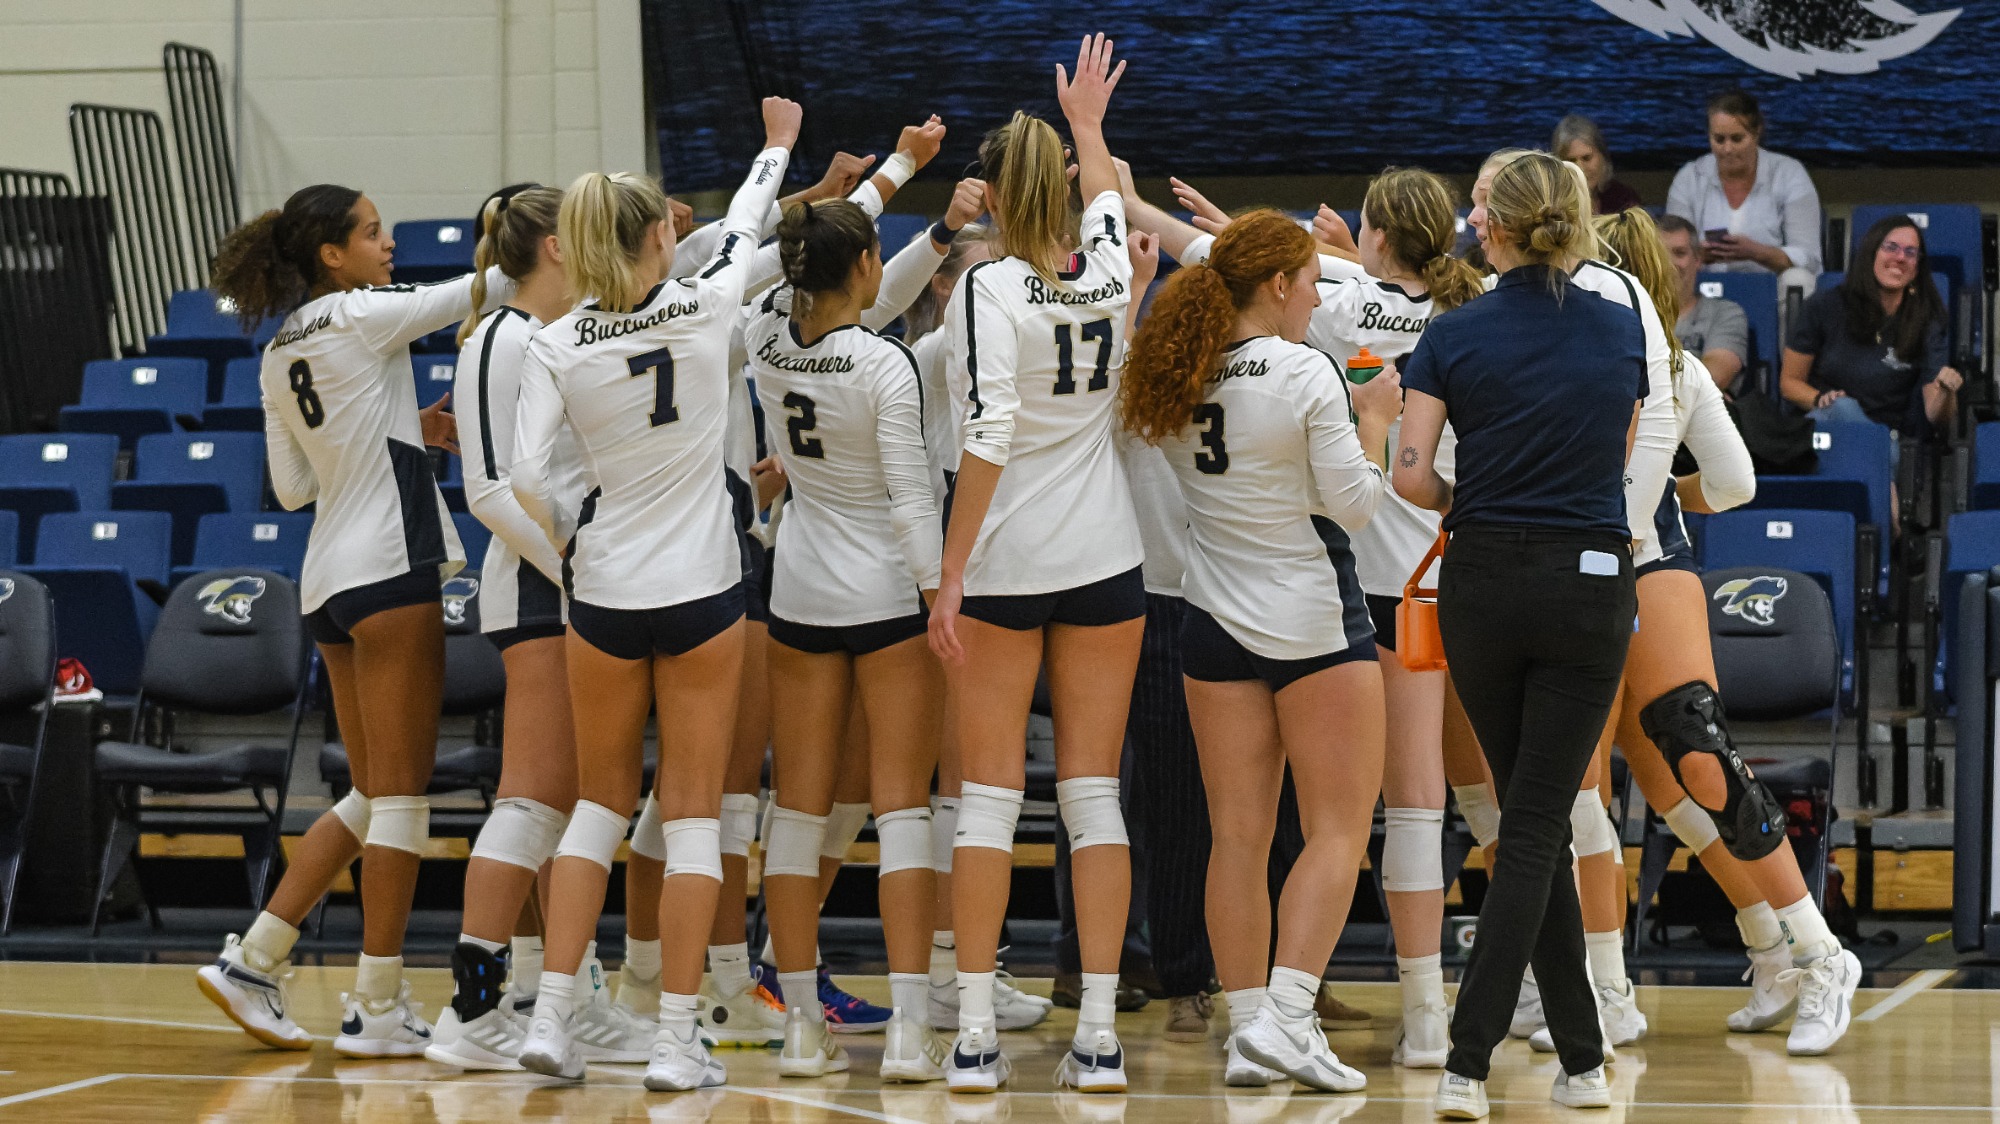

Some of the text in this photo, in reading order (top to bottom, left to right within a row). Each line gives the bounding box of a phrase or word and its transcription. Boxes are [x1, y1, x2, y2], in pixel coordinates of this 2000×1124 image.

[574, 299, 699, 347] Buccaneers
[1051, 316, 1113, 397] 17
[288, 358, 326, 429] 8
[625, 345, 681, 428] 7
[782, 390, 826, 460] 2
[1191, 402, 1230, 476] 3
